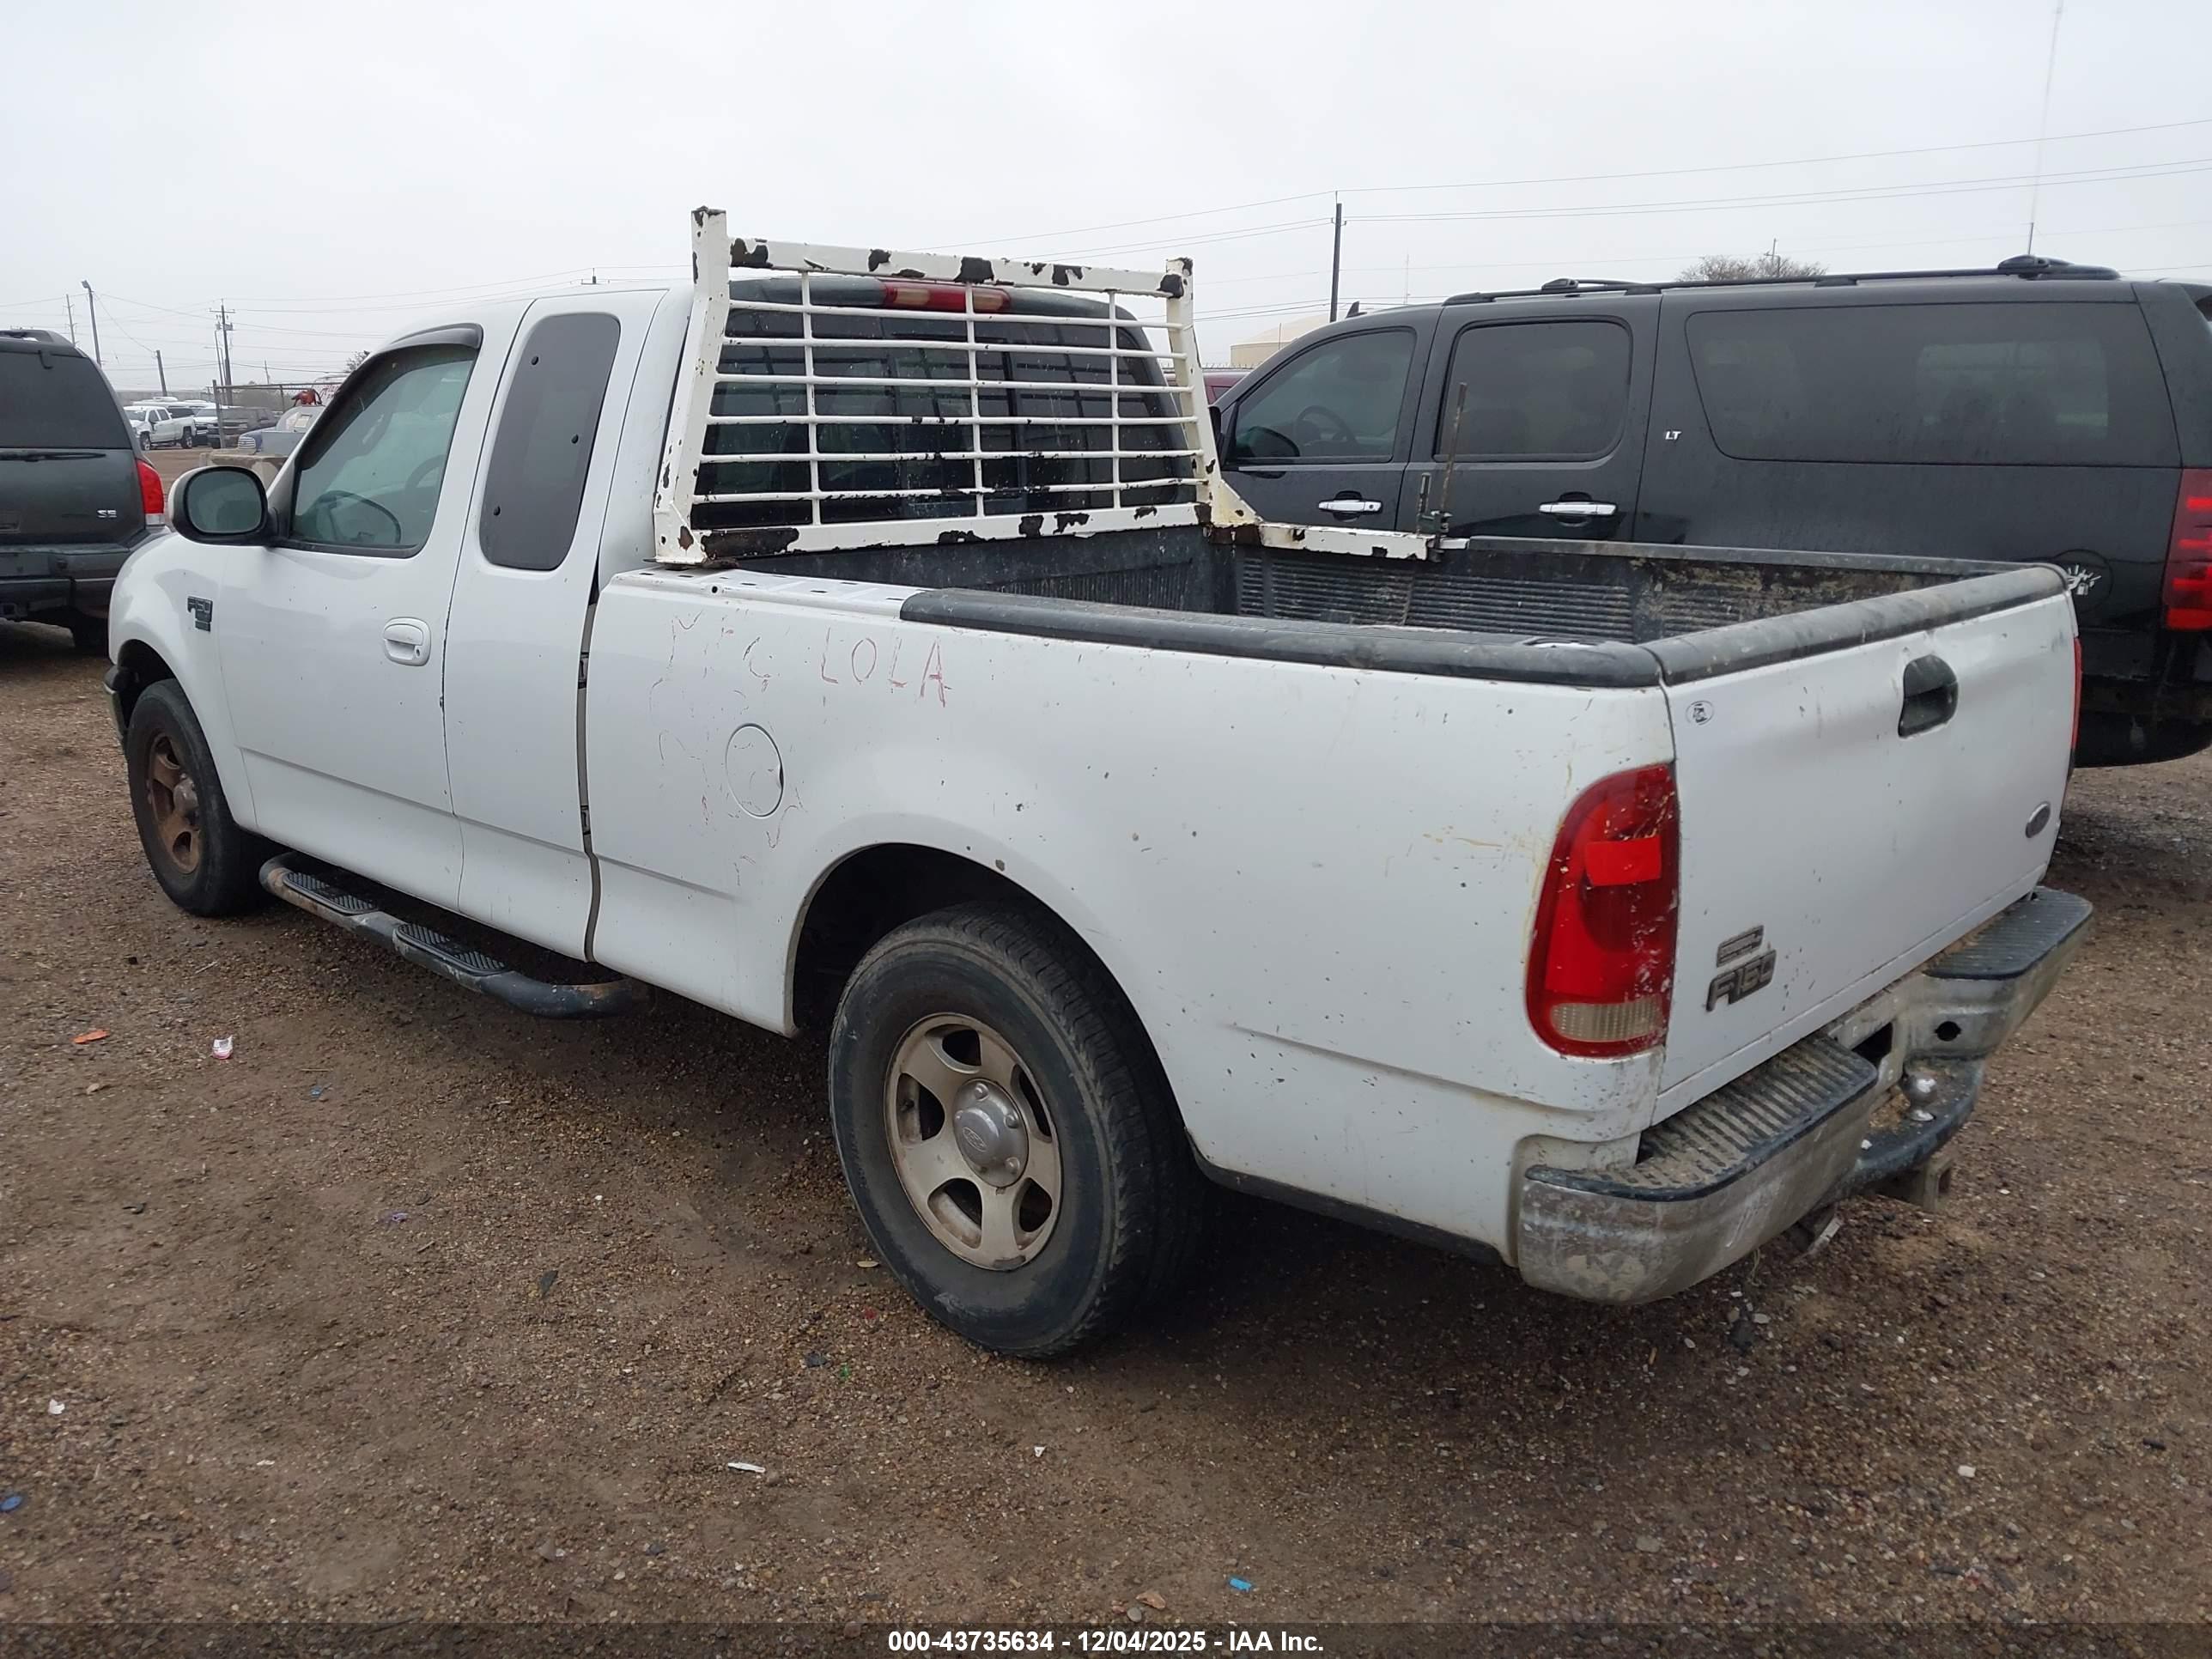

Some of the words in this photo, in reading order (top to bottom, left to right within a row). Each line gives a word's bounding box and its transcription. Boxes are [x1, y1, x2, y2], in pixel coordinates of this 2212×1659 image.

[1665, 430, 1682, 441] LT
[96, 509, 118, 519] SE
[821, 627, 949, 708] LOLA
